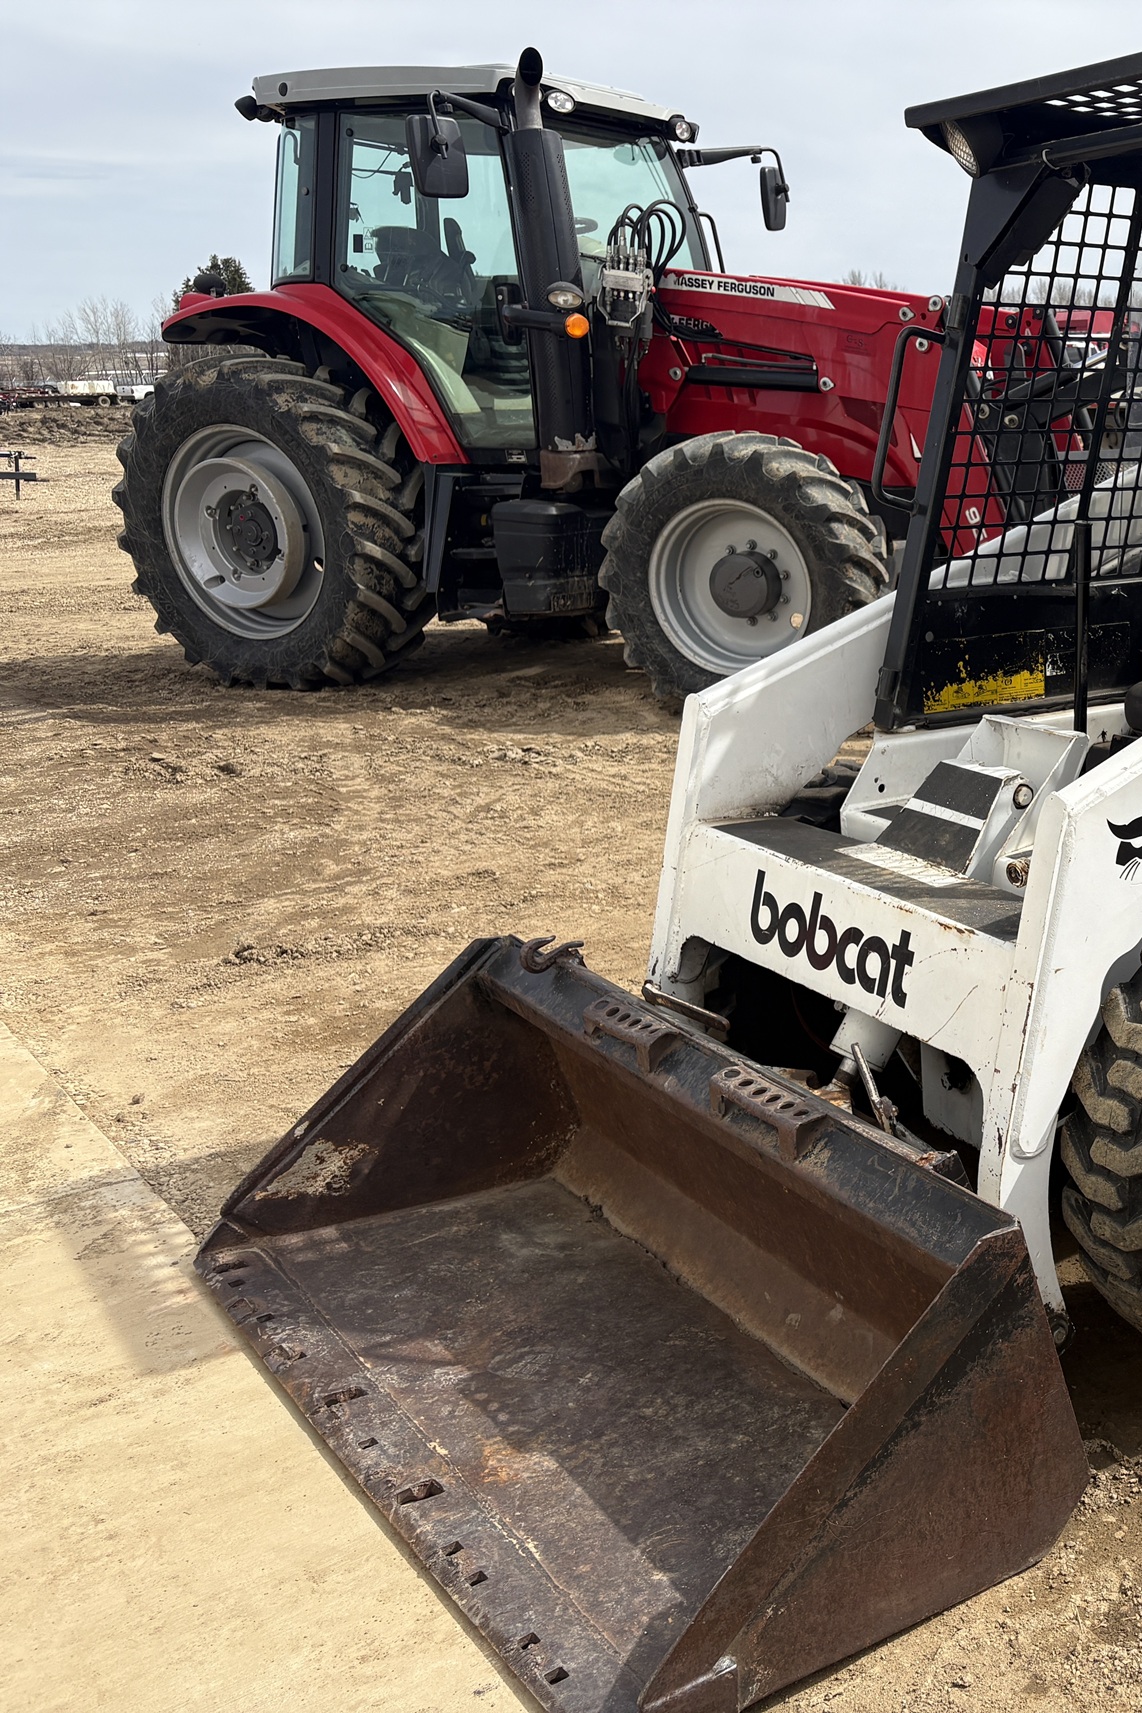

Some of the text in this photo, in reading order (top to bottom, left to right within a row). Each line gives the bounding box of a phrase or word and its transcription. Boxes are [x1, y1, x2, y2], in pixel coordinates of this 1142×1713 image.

[673, 277, 775, 297] MASSEY FERGUSON
[750, 868, 915, 1009] bobcat
